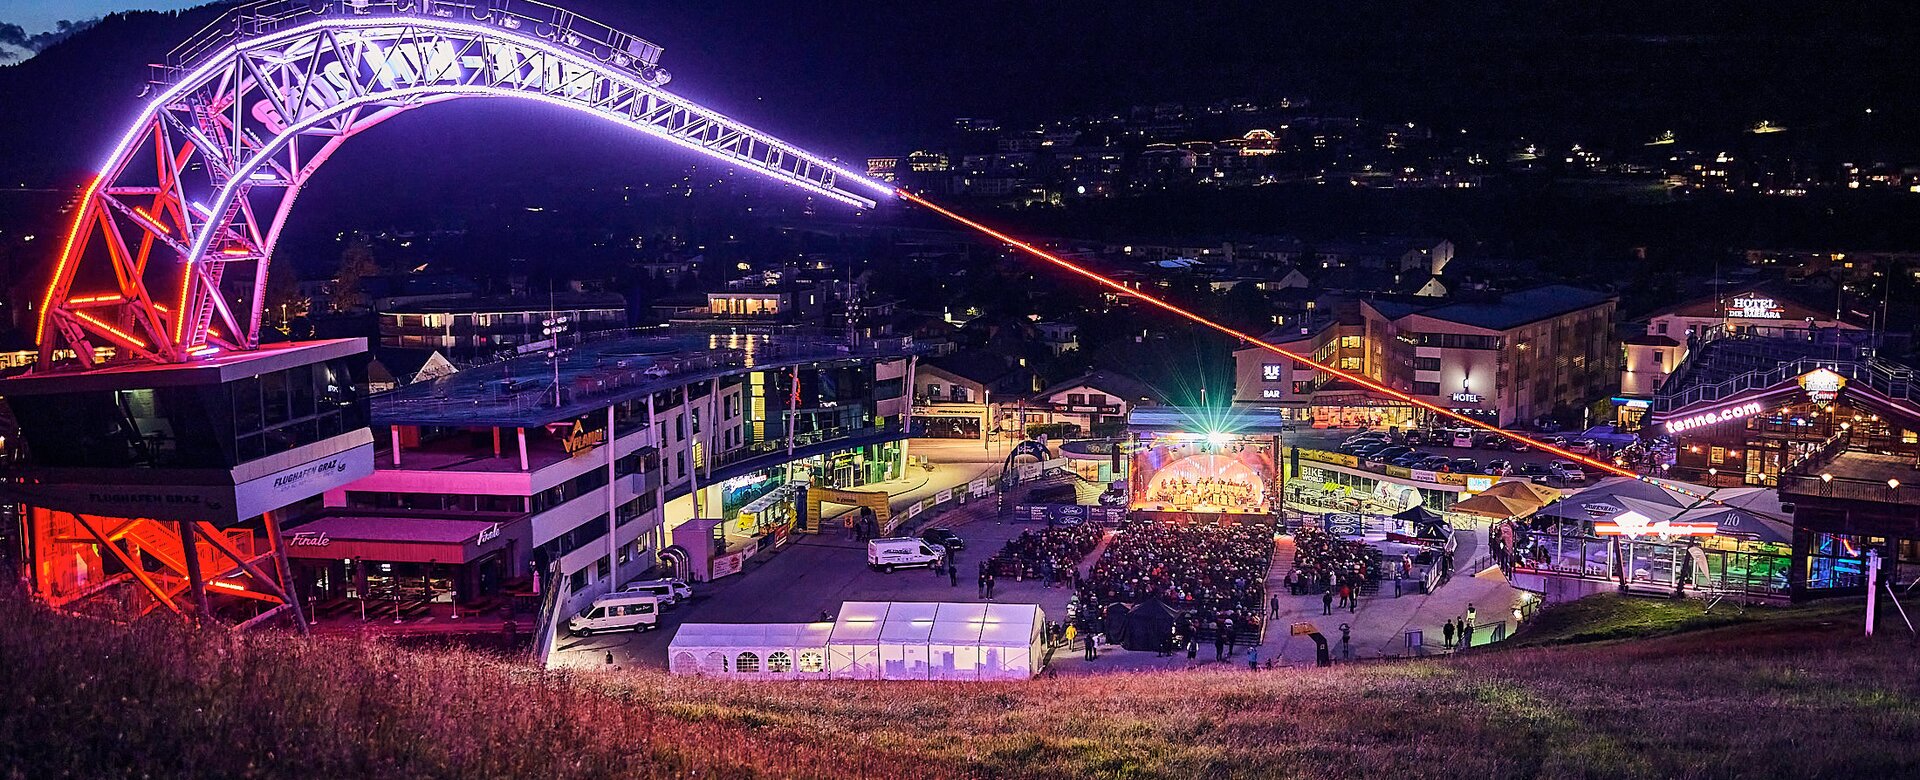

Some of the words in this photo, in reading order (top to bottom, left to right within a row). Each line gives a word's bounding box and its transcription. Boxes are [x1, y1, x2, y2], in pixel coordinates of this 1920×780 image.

[1733, 298, 1777, 309] HOTEL
[1744, 311, 1781, 319] BARBARA
[1263, 389, 1280, 398] BAR
[1452, 393, 1478, 402] HOTEL
[1665, 402, 1761, 434] tenne.com
[274, 466, 317, 487] FLUGHAFEN
[317, 460, 338, 473] GRAZ
[1302, 467, 1324, 478] BIKE
[1302, 475, 1324, 483] WORLD
[165, 495, 200, 504] GRAZ
[290, 531, 330, 546] Finale
